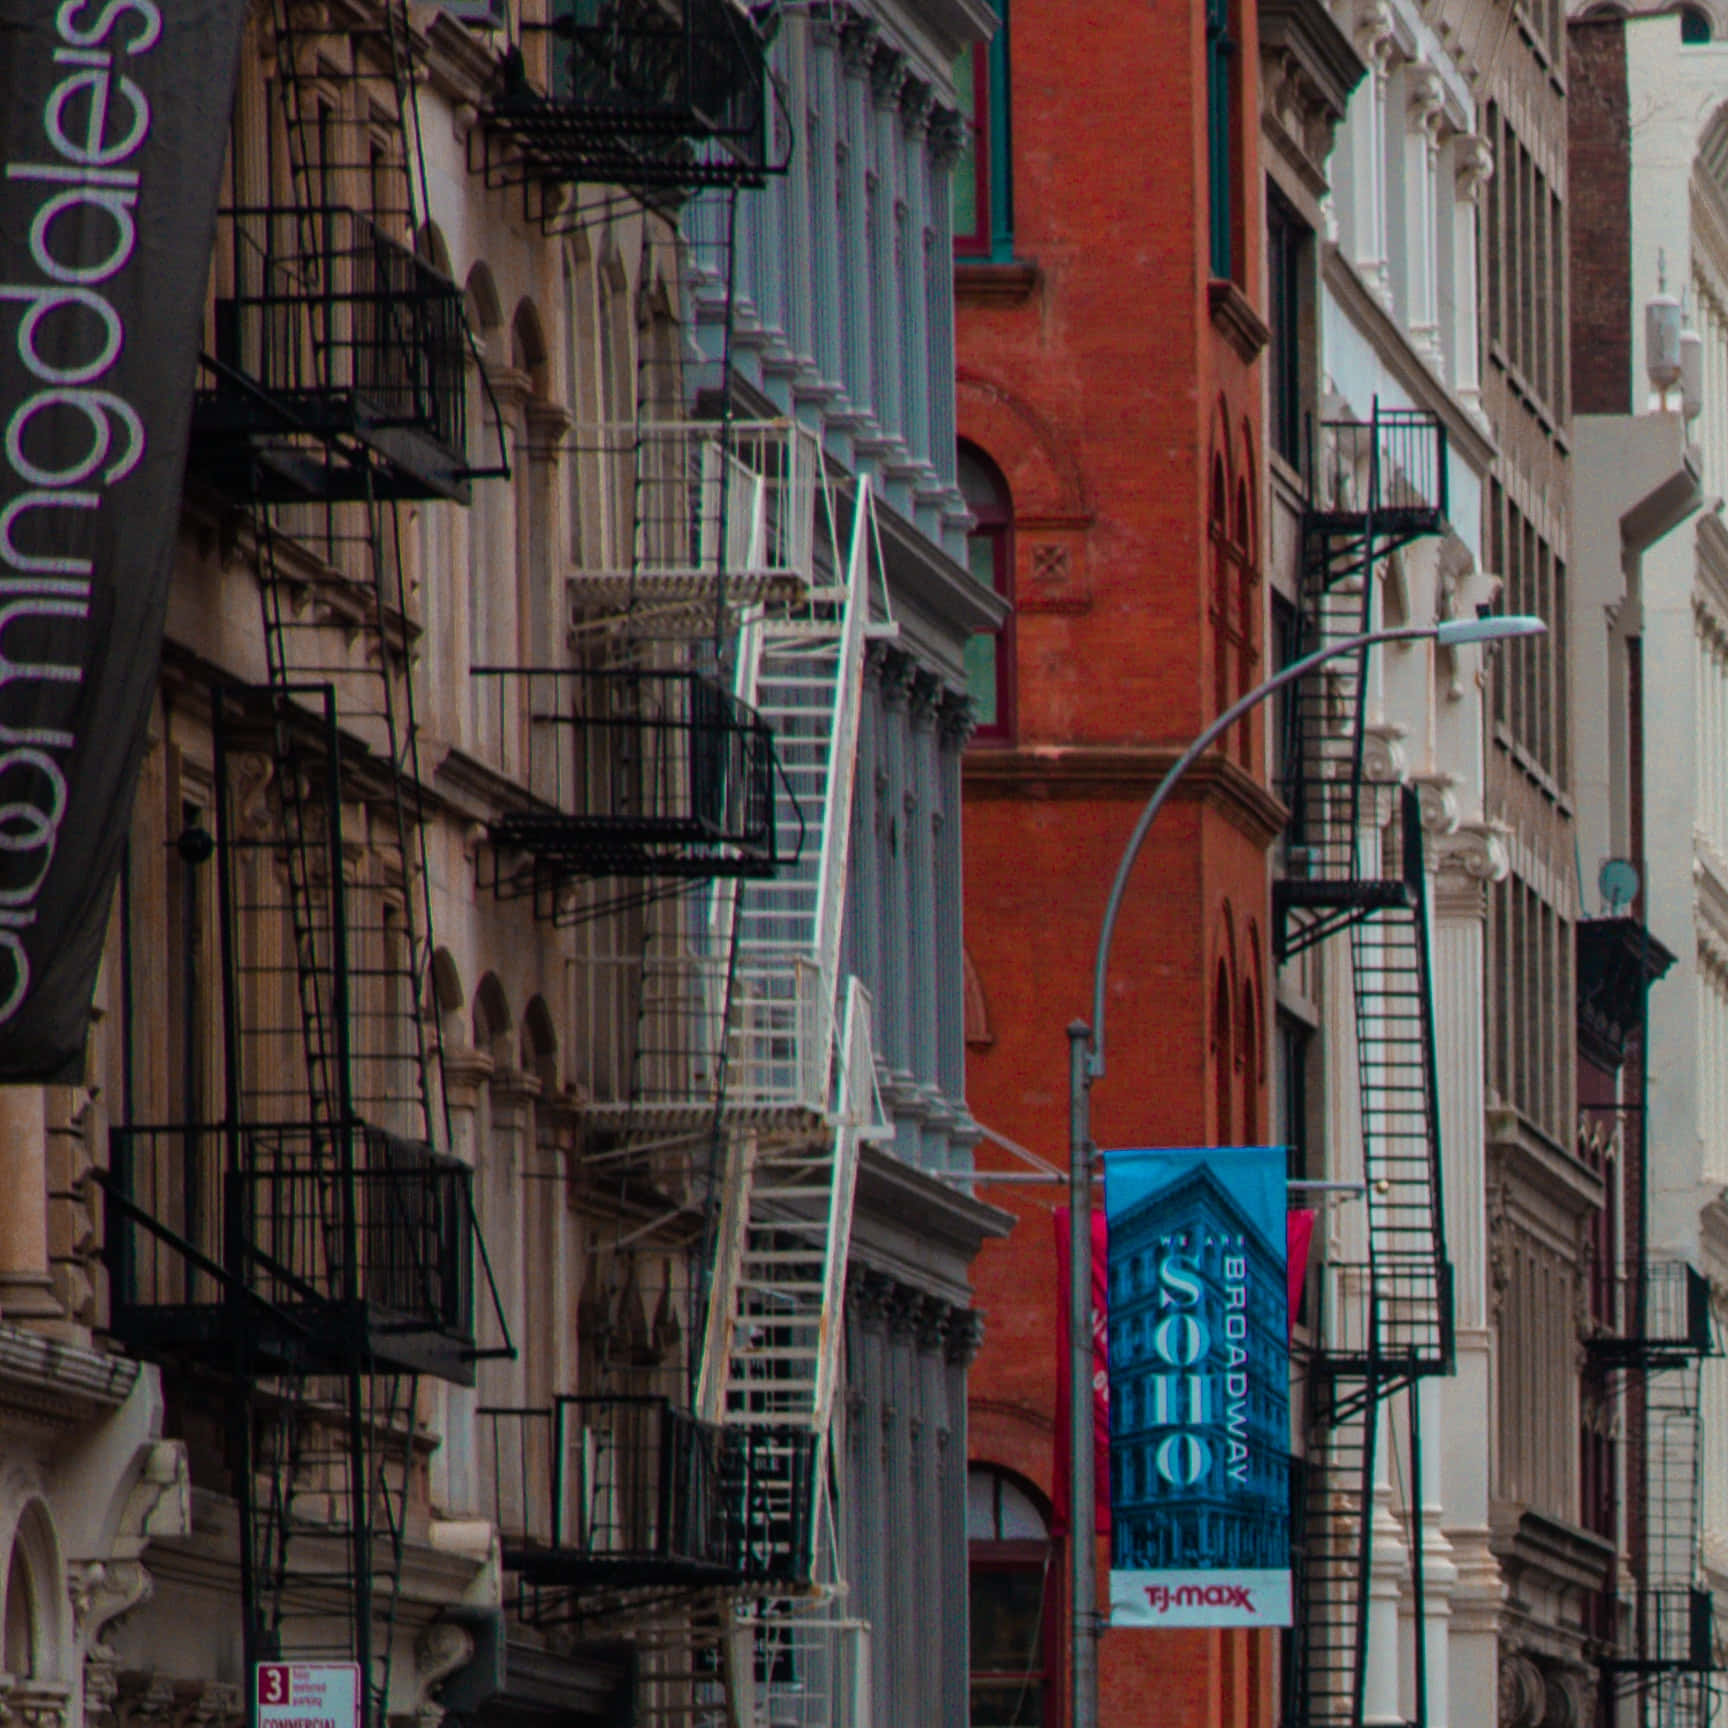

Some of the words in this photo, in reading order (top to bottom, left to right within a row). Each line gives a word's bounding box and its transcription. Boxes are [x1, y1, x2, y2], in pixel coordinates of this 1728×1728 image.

[1160, 1235, 1189, 1248] WE
[1206, 1235, 1246, 1248] ARE
[1223, 1256, 1250, 1485] BROADWAY
[265, 1667, 284, 1703] 3
